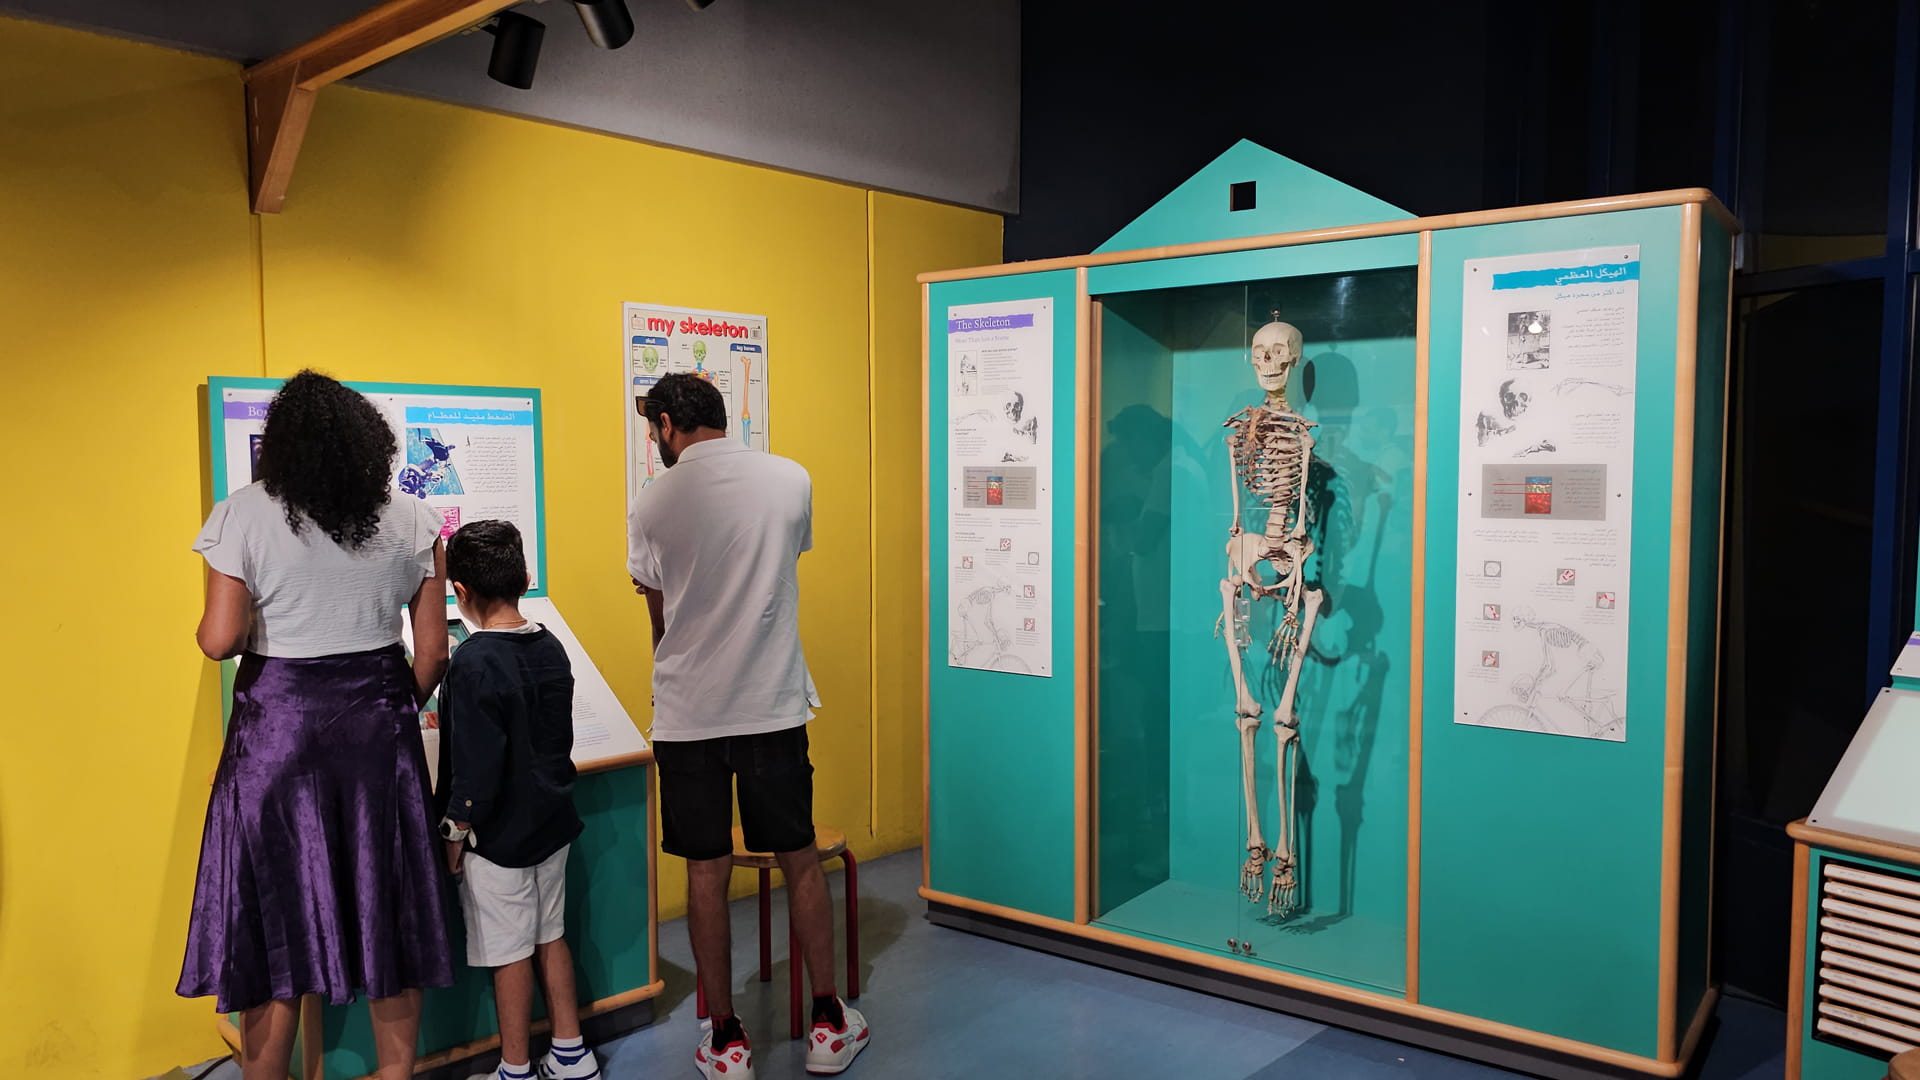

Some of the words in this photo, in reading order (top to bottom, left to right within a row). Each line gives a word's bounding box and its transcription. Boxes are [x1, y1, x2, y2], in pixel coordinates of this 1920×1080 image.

[1555, 269, 1594, 286] العظمي
[1595, 266, 1626, 279] الهيكل
[647, 317, 675, 337] my
[679, 316, 749, 339] skeleton
[955, 319, 972, 330] The
[974, 317, 1010, 329] Skeleton
